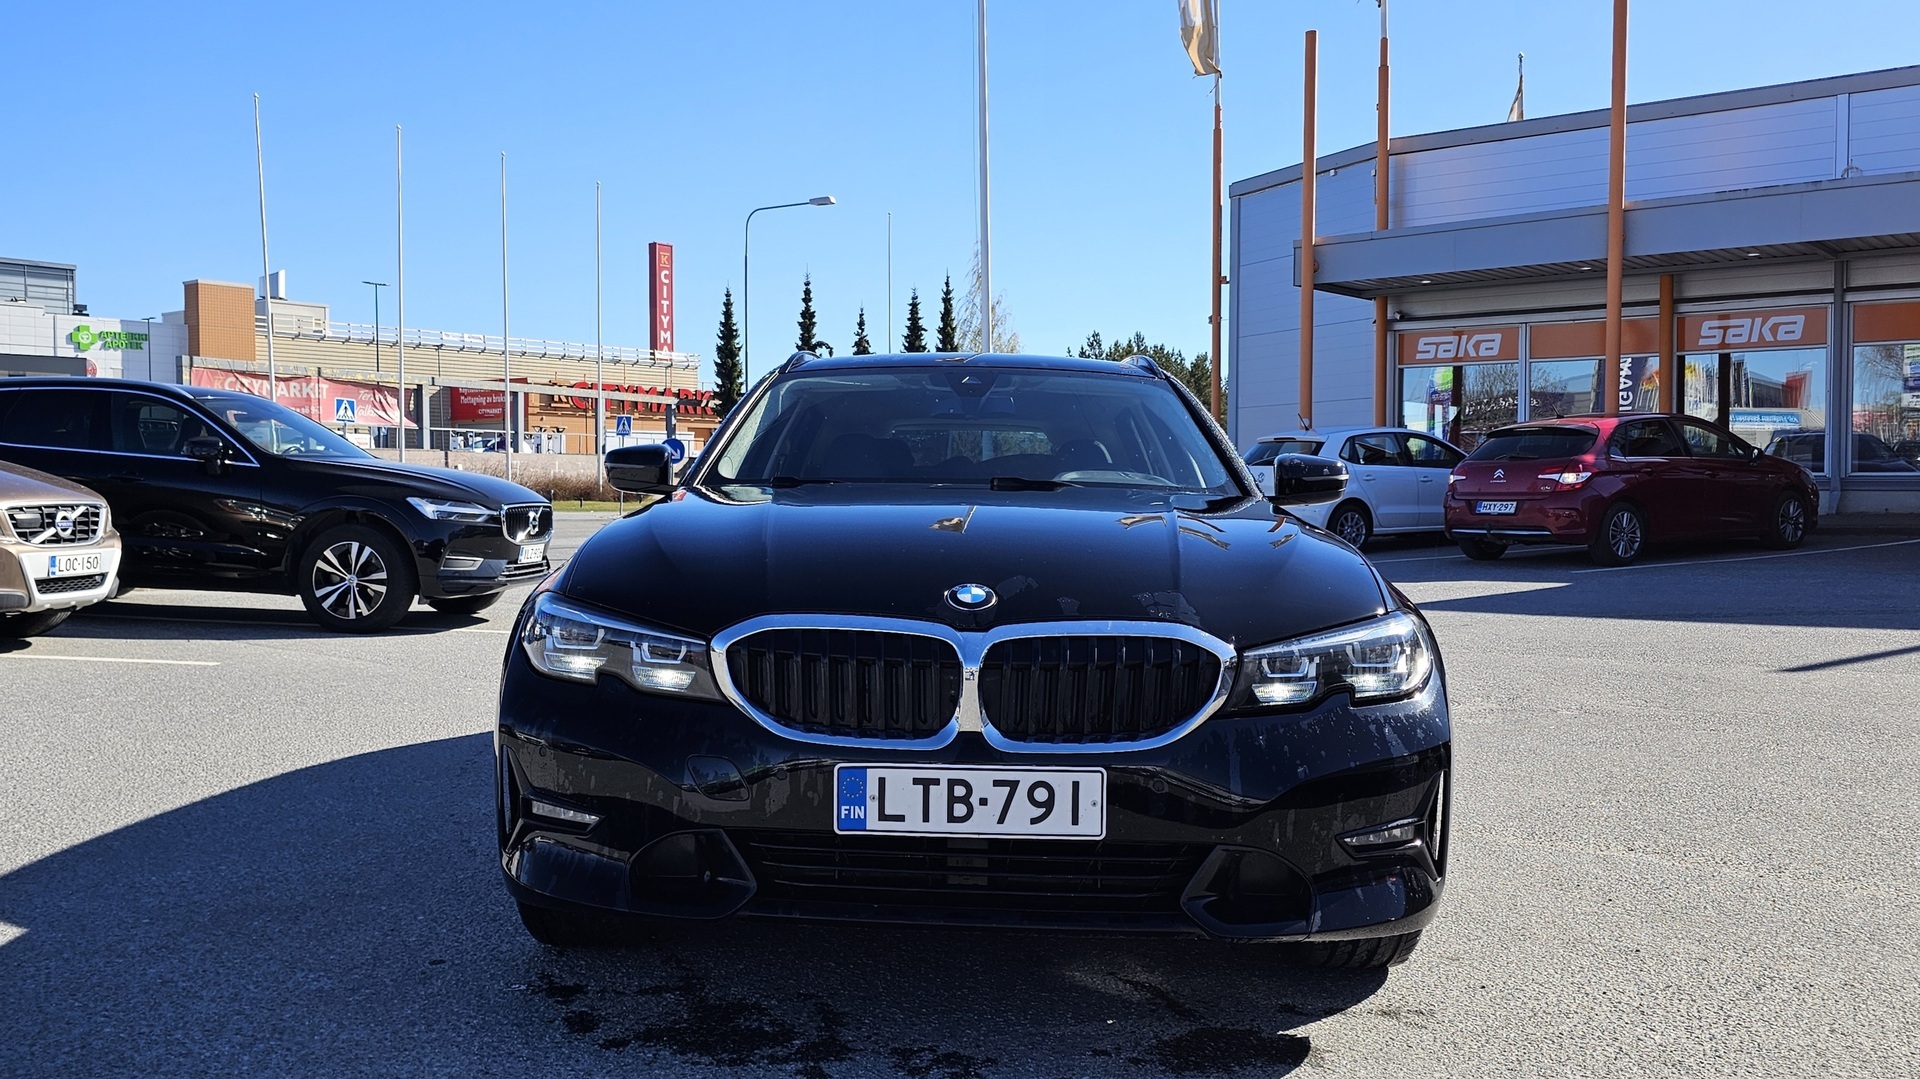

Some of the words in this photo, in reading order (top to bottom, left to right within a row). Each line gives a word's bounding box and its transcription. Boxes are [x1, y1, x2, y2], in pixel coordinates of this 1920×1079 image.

[104, 340, 143, 350] APOTEK
[1481, 501, 1515, 512] HXY-297
[58, 556, 99, 572] LOC-150
[878, 777, 1080, 826] LTB-791
[841, 805, 865, 819] FIN
